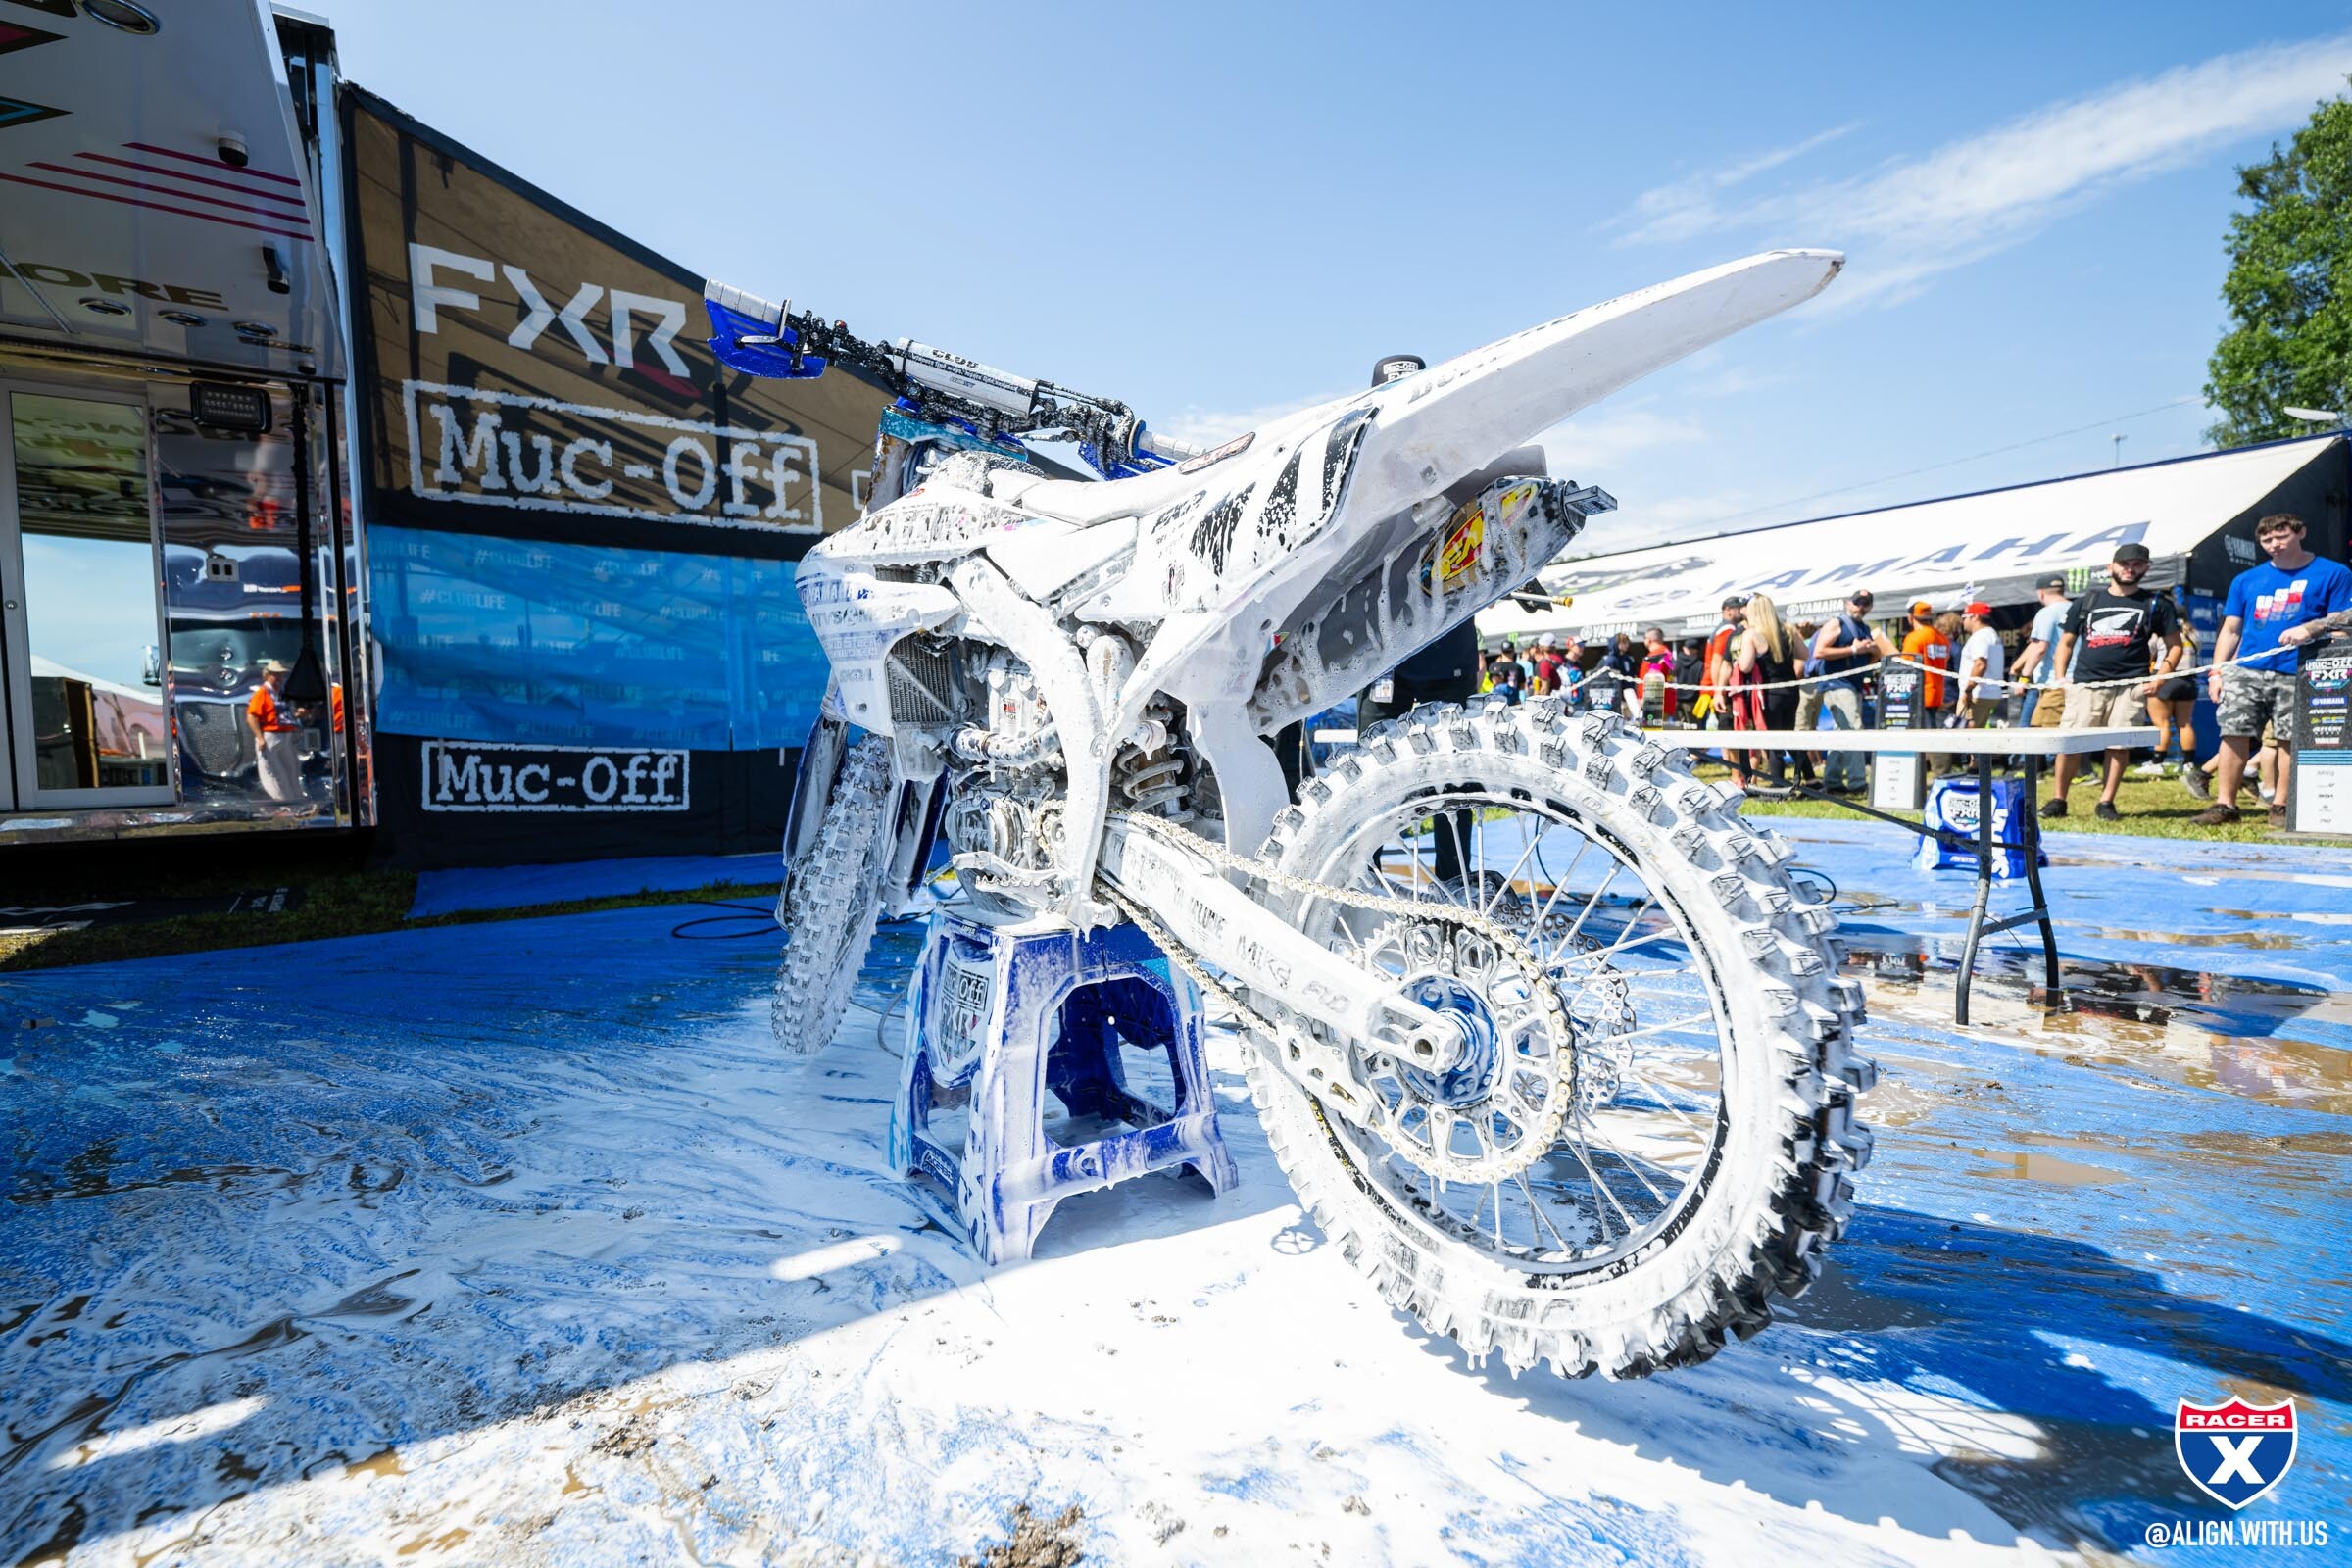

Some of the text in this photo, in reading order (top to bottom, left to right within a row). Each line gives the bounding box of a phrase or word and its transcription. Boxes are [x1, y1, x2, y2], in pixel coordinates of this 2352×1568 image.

[0, 262, 228, 311] ORE
[409, 242, 692, 379] FXR
[428, 404, 806, 521] Muc-Off
[2311, 669, 2348, 681] FXR
[436, 754, 679, 804] Muc-Off
